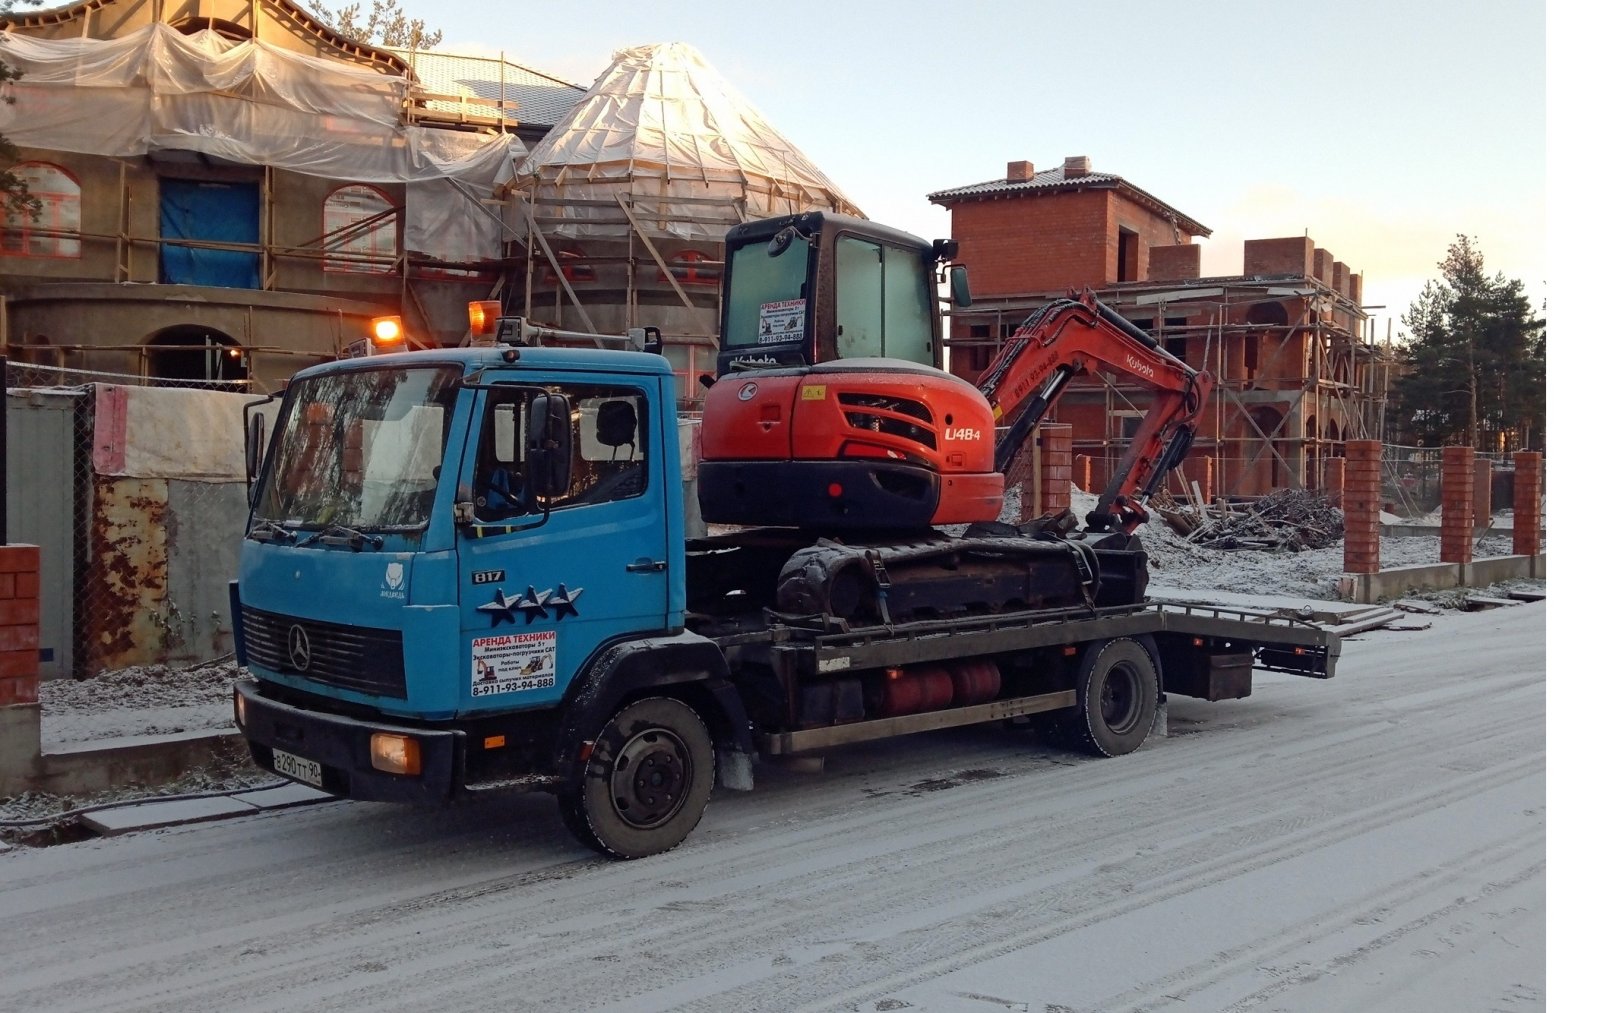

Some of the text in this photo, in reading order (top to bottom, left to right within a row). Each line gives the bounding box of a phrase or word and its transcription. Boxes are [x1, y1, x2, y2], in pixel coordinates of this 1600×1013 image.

[761, 302, 781, 310] АРЕНДА
[782, 299, 806, 307] ТЕХНИКИ
[1127, 354, 1154, 378] Kubota
[945, 428, 981, 441] U48-4
[475, 571, 502, 583] 817
[473, 631, 555, 648] АРЕНДА ТЕХНИКИ
[484, 643, 536, 653] Миниэкскаваторы
[473, 649, 545, 661] Экскаваторы-погрузчики
[472, 678, 554, 696] 8-911-93-94-888
[308, 762, 318, 778] 90
